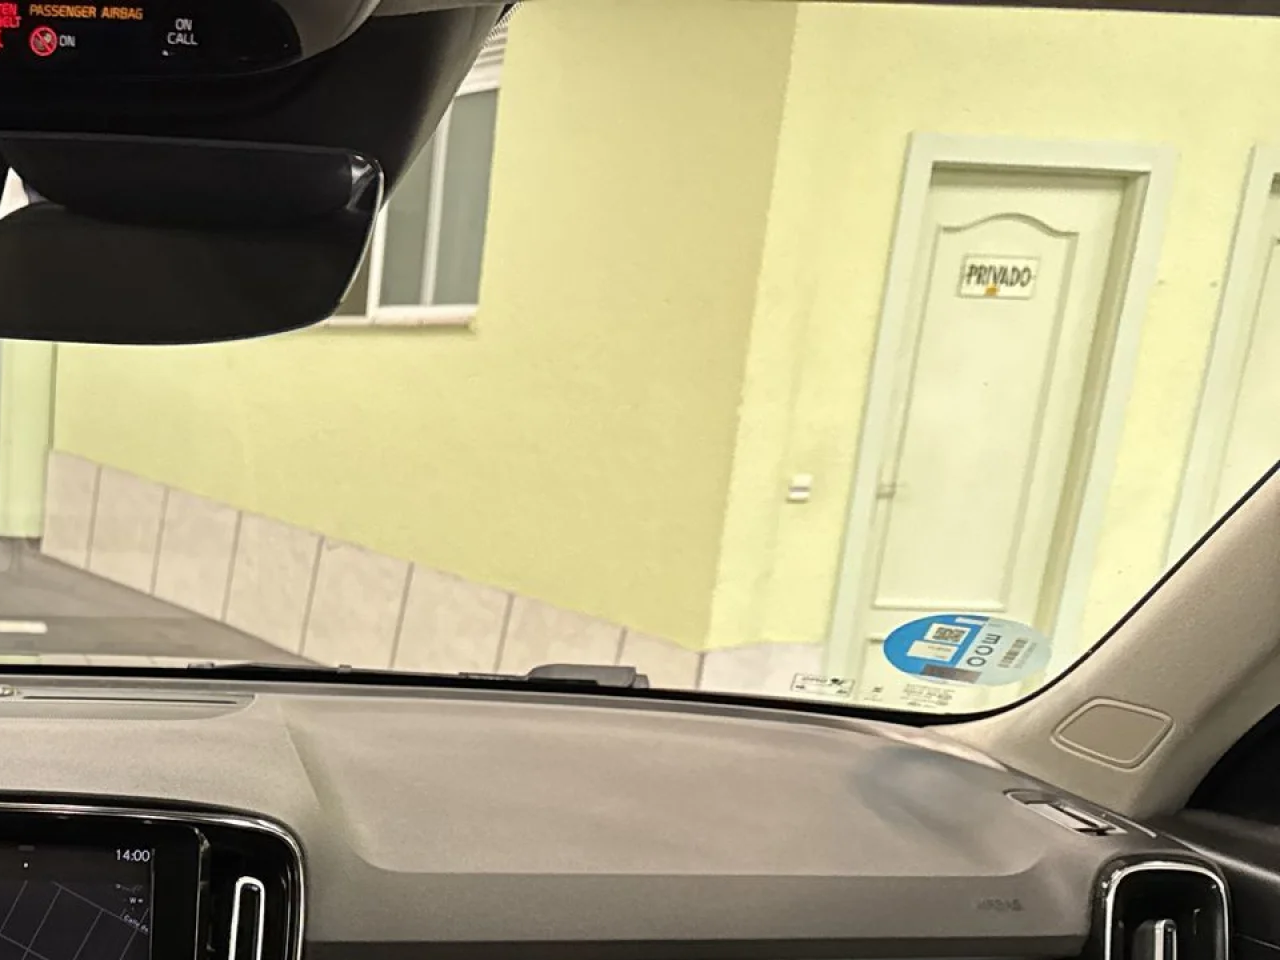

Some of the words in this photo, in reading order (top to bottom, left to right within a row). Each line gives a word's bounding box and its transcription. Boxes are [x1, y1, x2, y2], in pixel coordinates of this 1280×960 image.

[29, 4, 97, 17] PASSENGER
[101, 6, 144, 20] AIRBAG
[175, 18, 193, 31] ON
[59, 35, 76, 47] ON
[167, 32, 199, 45] CALL
[965, 263, 1032, 288] PRIVADO
[115, 849, 150, 862] 14:00
